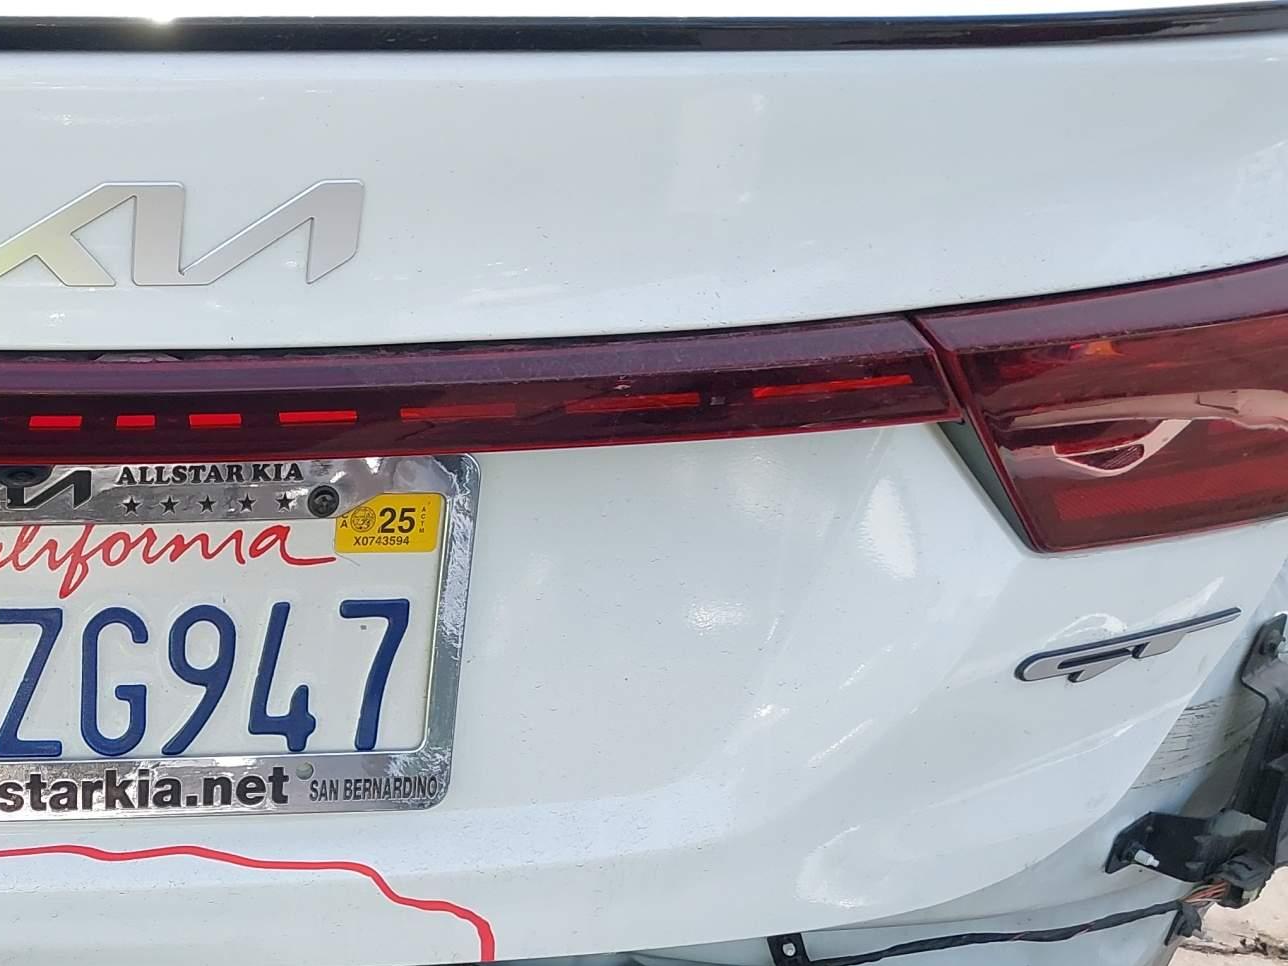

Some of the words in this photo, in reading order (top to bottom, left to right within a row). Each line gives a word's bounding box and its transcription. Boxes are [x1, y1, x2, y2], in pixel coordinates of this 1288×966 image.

[115, 463, 243, 486] ALLSTAR
[249, 462, 304, 483] KIA
[378, 507, 416, 534] 25
[353, 536, 410, 546] X0743594
[310, 778, 339, 801] SAN
[344, 775, 439, 801] BERNARDINO
